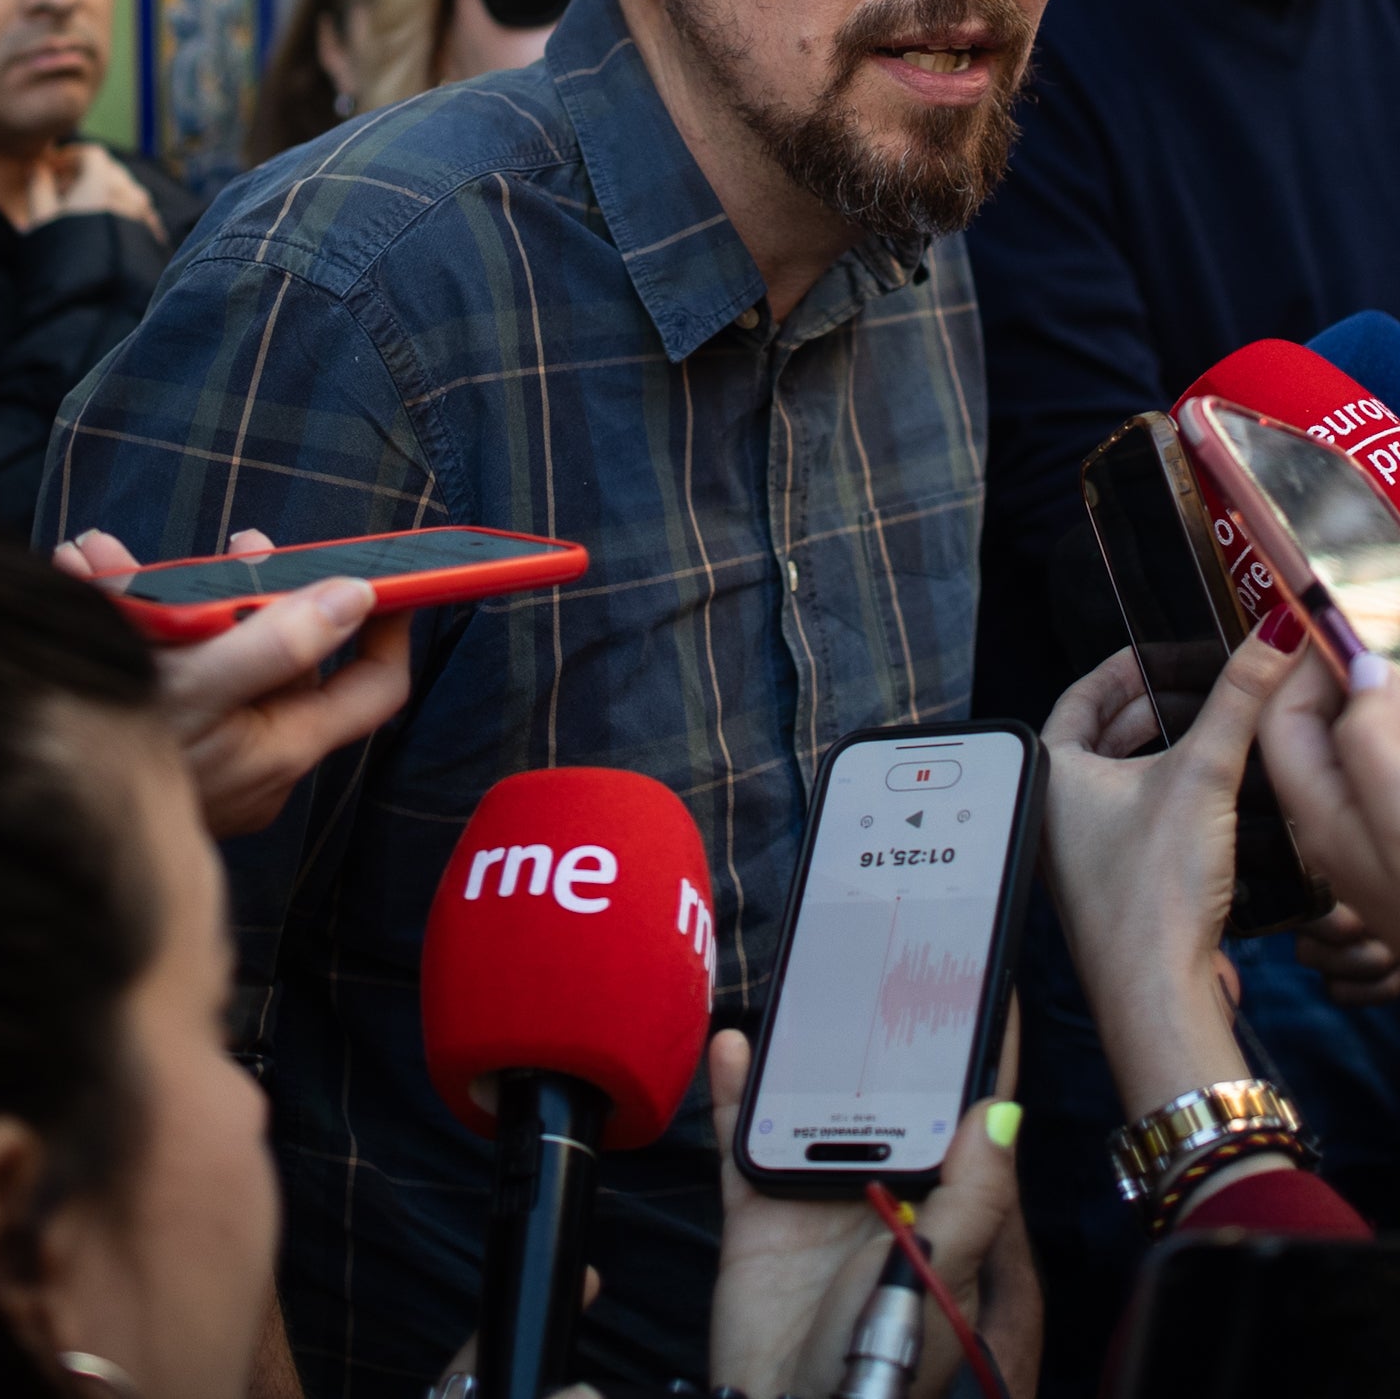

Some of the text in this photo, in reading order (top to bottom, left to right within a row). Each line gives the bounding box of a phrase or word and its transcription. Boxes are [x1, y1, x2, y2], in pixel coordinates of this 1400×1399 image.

[1305, 396, 1400, 446] europ
[1236, 561, 1274, 621] pre
[463, 843, 619, 914] rne
[859, 847, 956, 868] 01:25,16
[677, 877, 717, 1015] rn
[874, 1127, 906, 1139] Nova
